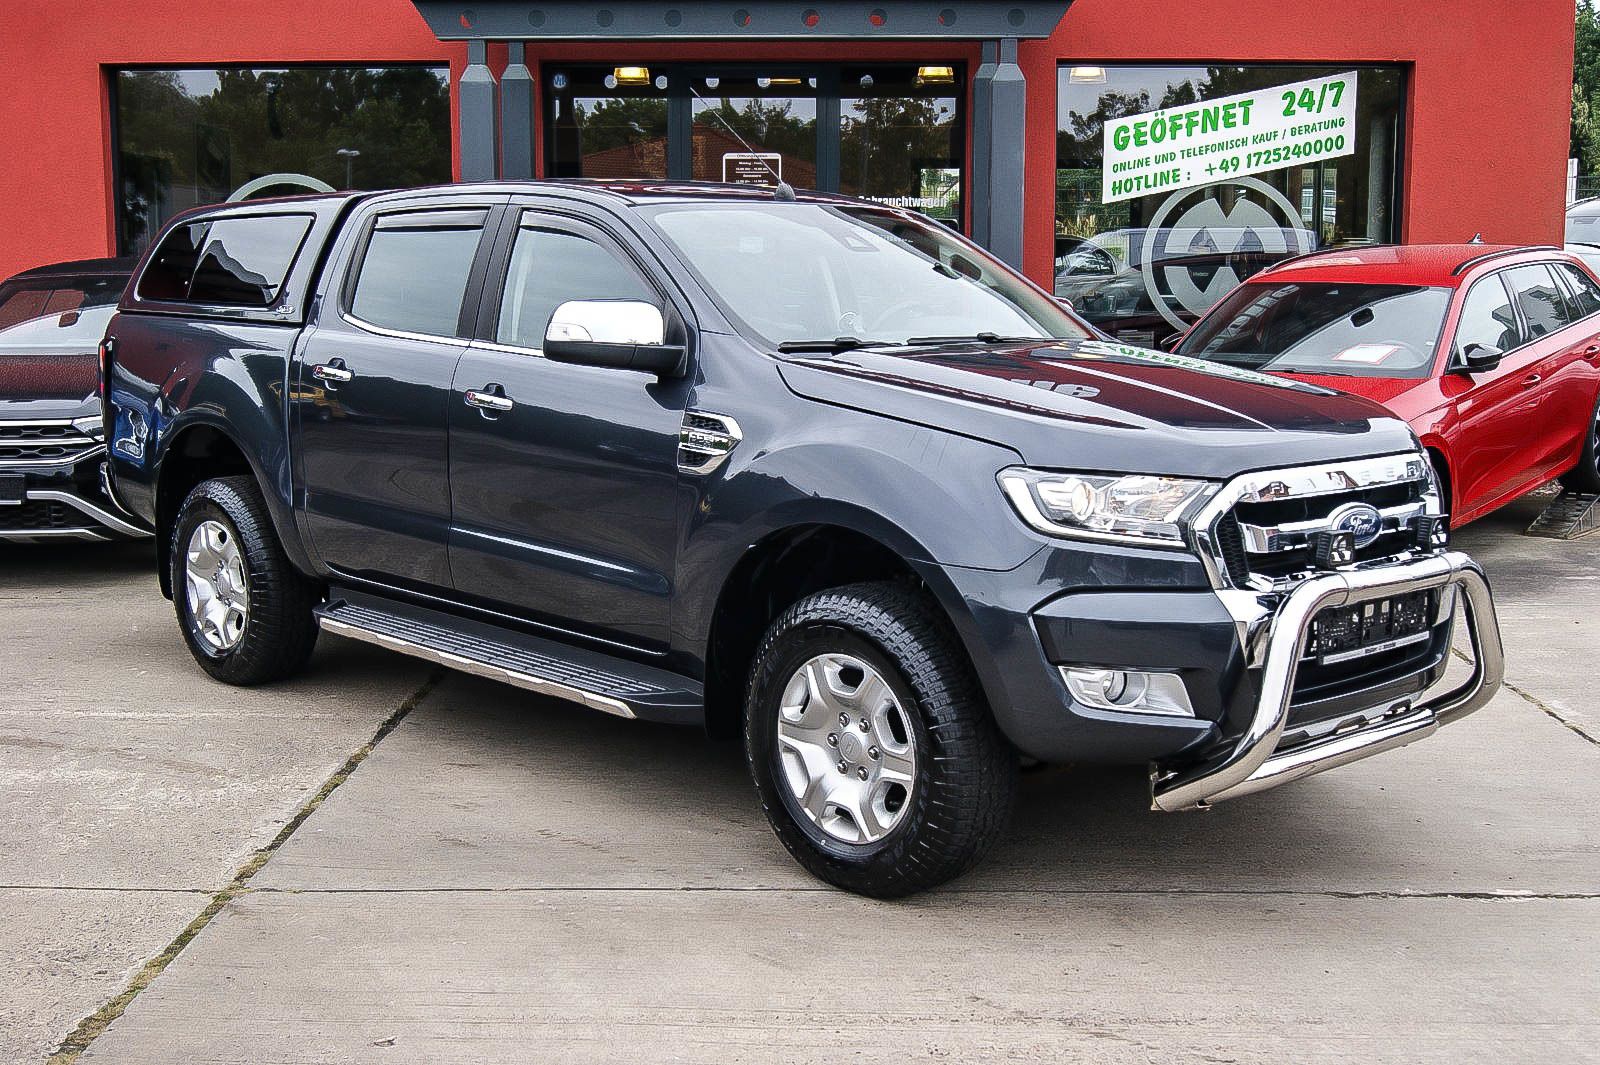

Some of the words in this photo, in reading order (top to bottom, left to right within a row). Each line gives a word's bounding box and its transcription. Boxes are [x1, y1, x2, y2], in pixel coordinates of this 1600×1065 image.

[1112, 157, 1151, 174] ONLINE
[1154, 151, 1177, 165] UND
[1180, 136, 1249, 160] TELEFONISCH
[1252, 130, 1279, 145] KAUF
[1290, 117, 1346, 137] BERATUNG
[1113, 99, 1254, 152] GEÖFFNET
[1281, 80, 1346, 117] 24/7
[1111, 168, 1181, 196] HOTLINE
[1204, 156, 1240, 176] +49
[1246, 134, 1346, 169] 1725240000
[1349, 514, 1376, 536] Ford
